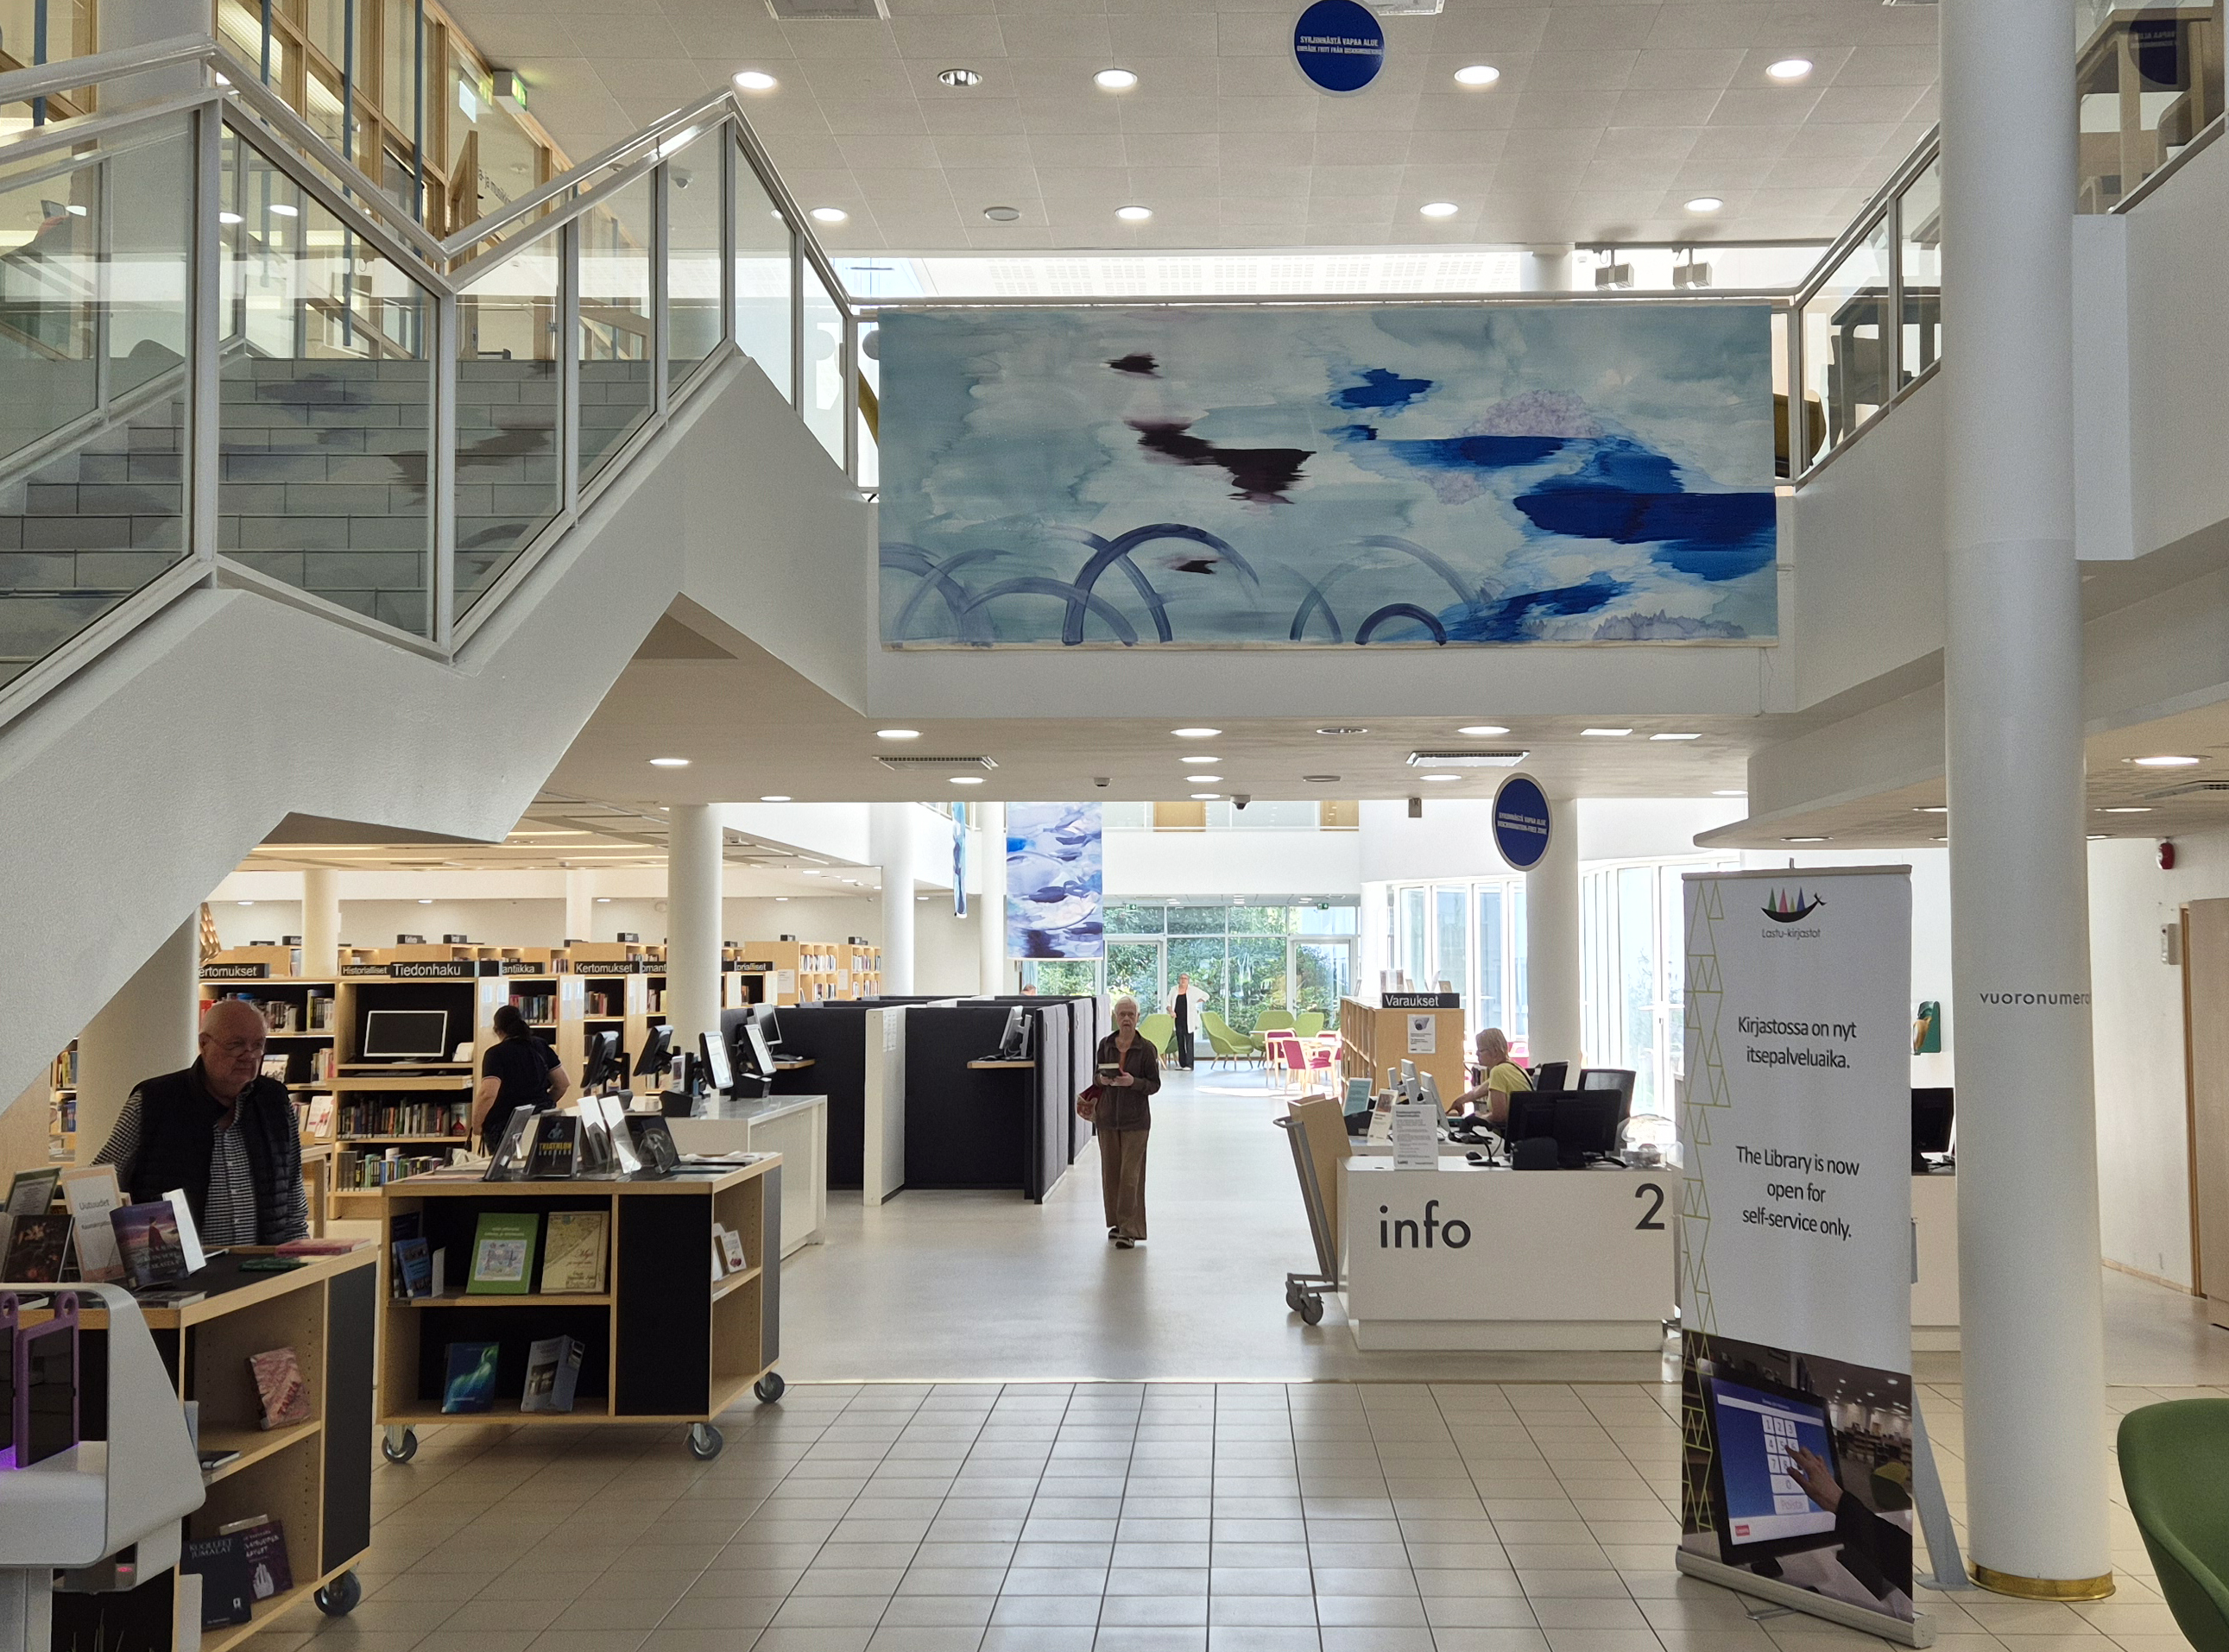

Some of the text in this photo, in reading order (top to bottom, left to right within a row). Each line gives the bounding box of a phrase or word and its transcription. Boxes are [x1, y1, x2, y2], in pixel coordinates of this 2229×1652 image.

[1762, 928, 1821, 939] Lastu-kirjastot
[199, 965, 257, 977] ertomukset
[342, 965, 388, 975] Historialliset
[395, 963, 461, 976] Tiedonhaku
[502, 963, 535, 974] antiikka
[576, 962, 633, 974] Kertomukset
[1385, 993, 1439, 1007] Varaukset
[1738, 1017, 1857, 1041] Kirjastossa on nyt
[1746, 1045, 1850, 1069] itsepalveluaika.
[1736, 1146, 1860, 1176] The Library is now
[1767, 1182, 1826, 1202] open for
[1635, 1183, 1665, 1229] 2
[1380, 1200, 1471, 1248] info
[1743, 1207, 1851, 1240] self-service only.
[1765, 1420, 1793, 1434] 1 2 3
[1768, 1439, 1773, 1449] 4
[1779, 1441, 1784, 1451] 5
[1771, 1459, 1776, 1470] 7
[1785, 1479, 1791, 1490] 0
